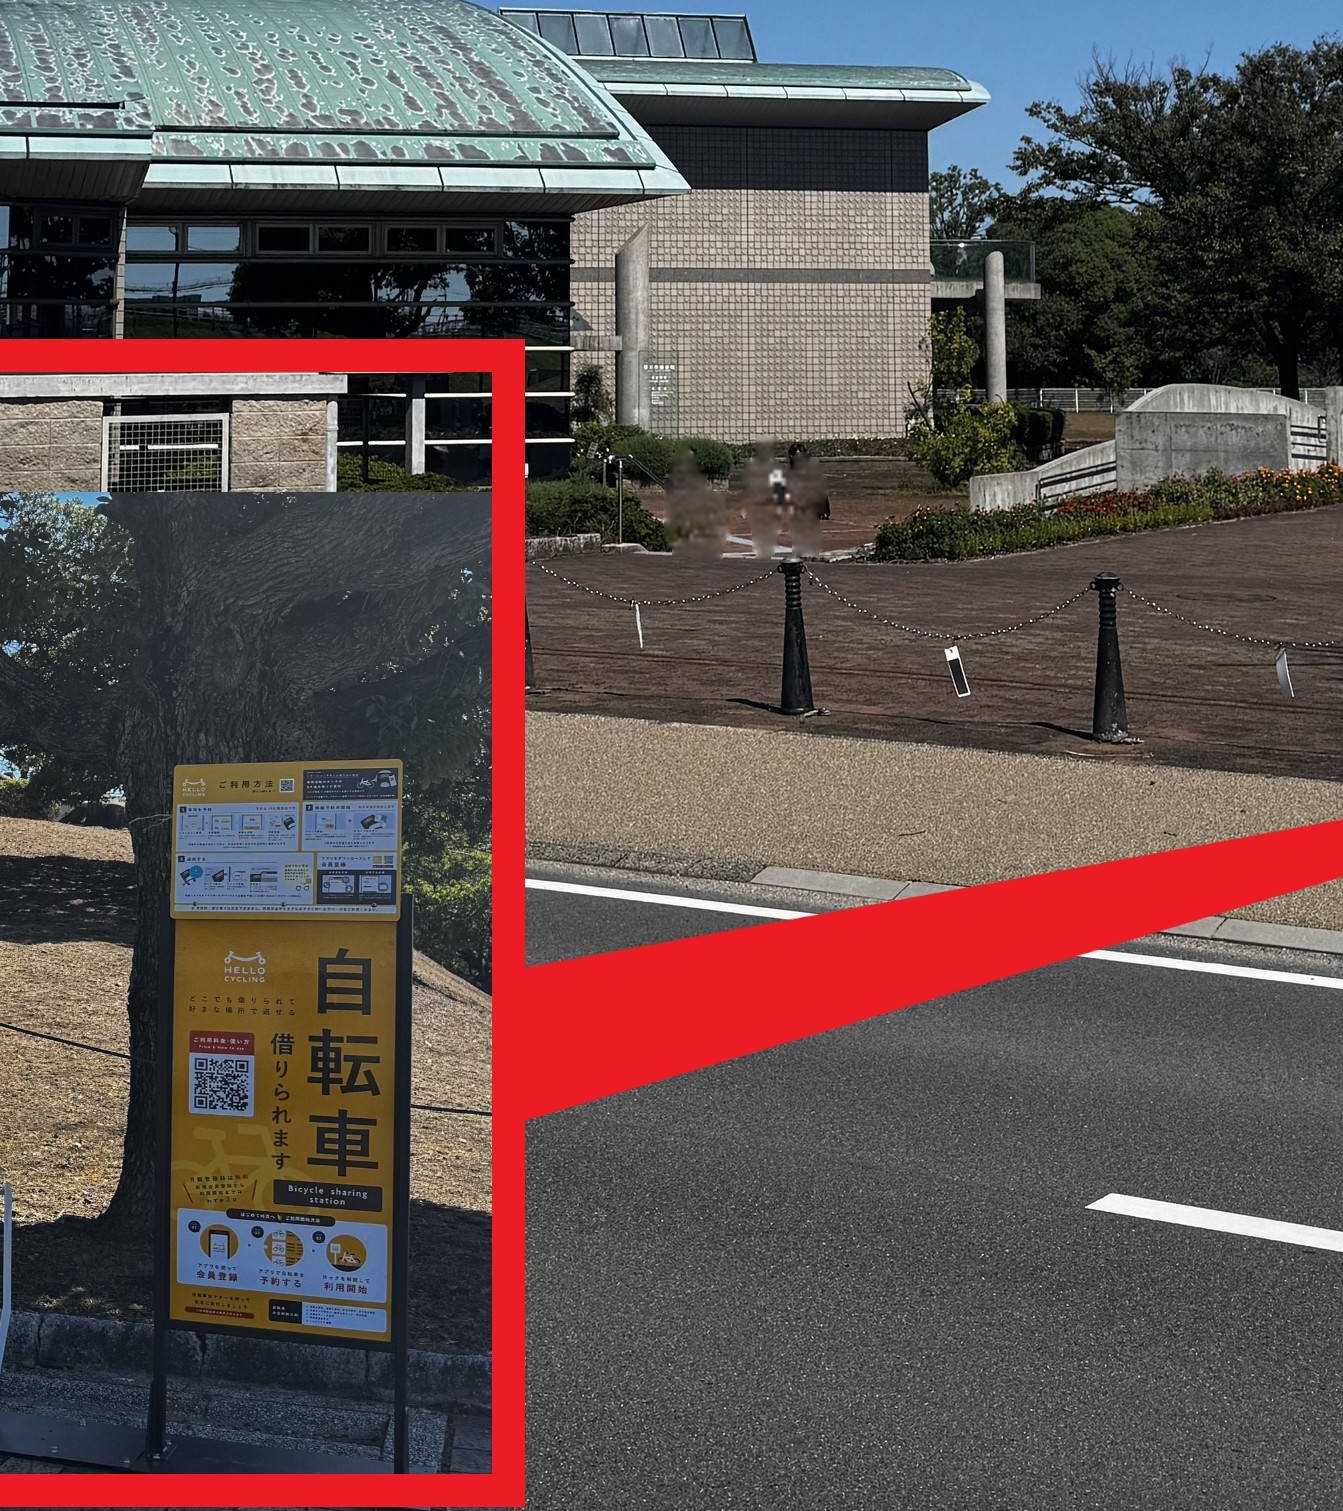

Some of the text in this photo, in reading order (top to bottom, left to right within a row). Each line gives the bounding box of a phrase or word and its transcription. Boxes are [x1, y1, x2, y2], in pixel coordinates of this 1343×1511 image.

[224, 966, 265, 975] HELLO
[307, 948, 381, 1177] 自転車
[271, 1033, 295, 1170] 借りられます
[288, 1184, 369, 1200] Bicycle sharing
[309, 1197, 346, 1206] station
[196, 1270, 238, 1282] 会員登録
[260, 1276, 302, 1288] 予約する
[324, 1282, 368, 1294] 利用開始
